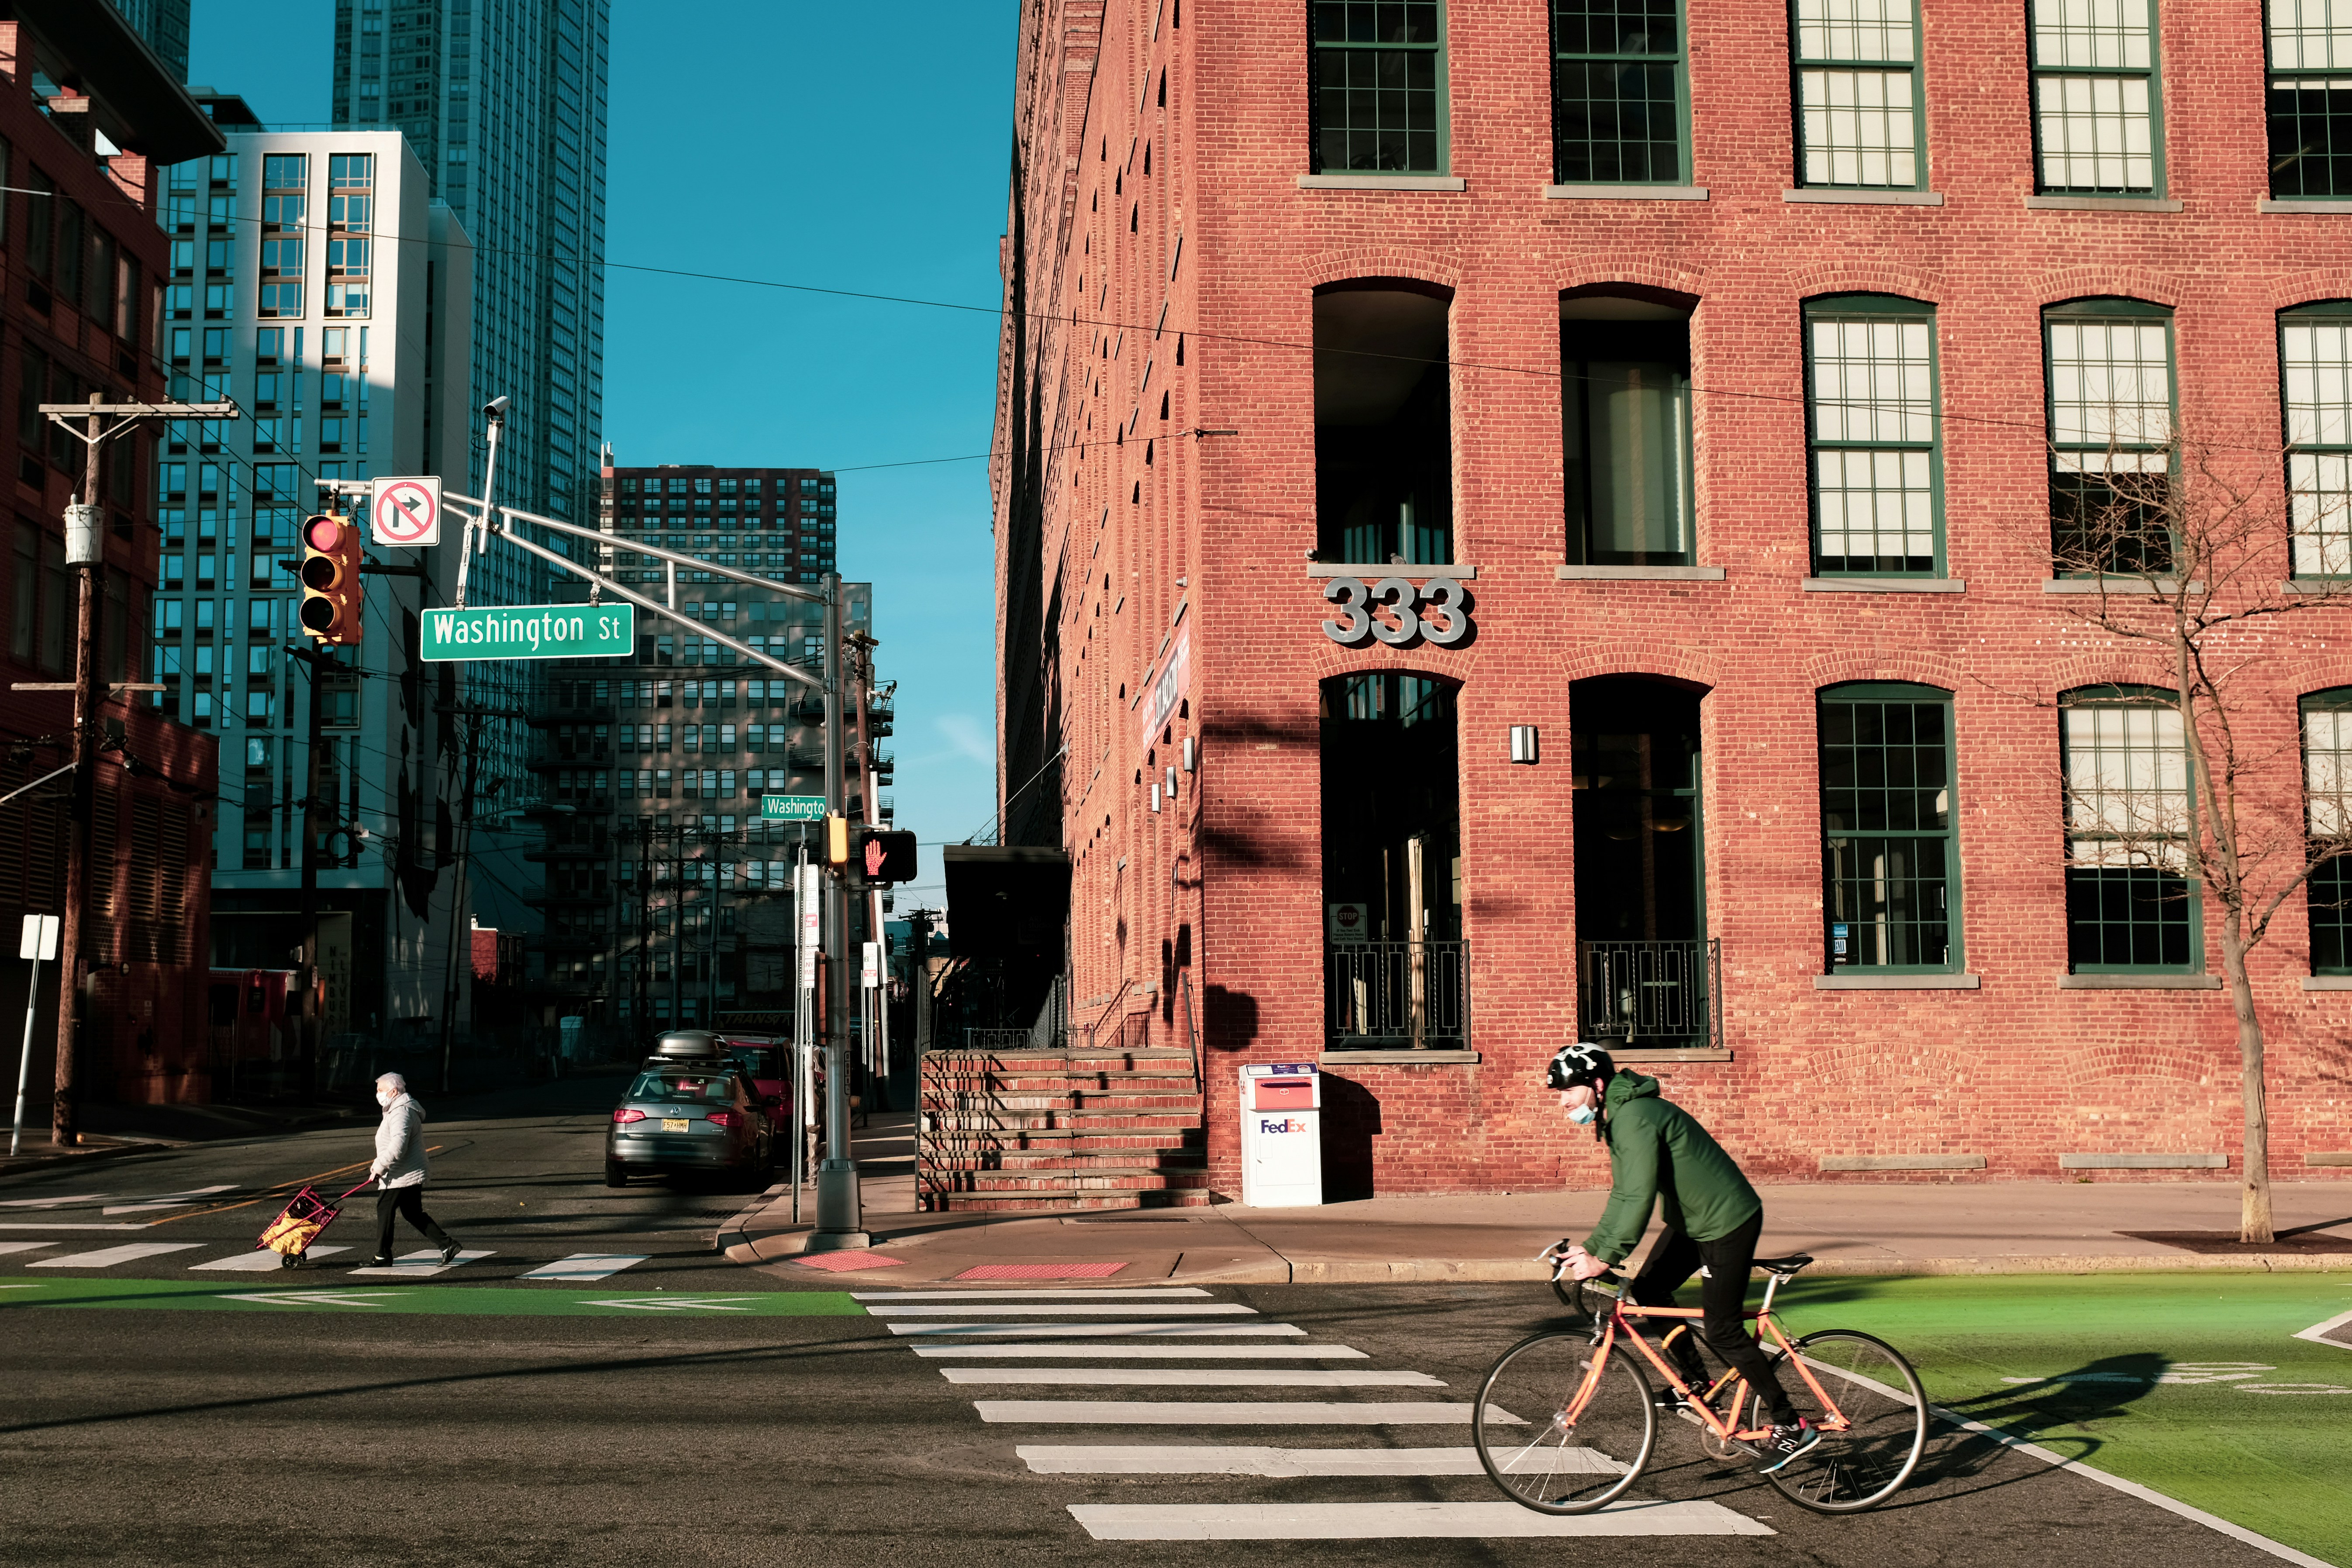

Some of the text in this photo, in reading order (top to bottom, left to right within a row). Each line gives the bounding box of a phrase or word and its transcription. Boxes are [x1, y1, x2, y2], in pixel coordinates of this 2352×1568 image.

[1322, 576, 1466, 643] 333
[434, 612, 620, 651] Washington St
[1155, 655, 1178, 726] 201.842.6700
[768, 798, 825, 819] Washingto
[1834, 941, 1845, 950] BMI
[725, 1013, 791, 1024] TRANSIT
[1261, 1119, 1307, 1134] FedEx
